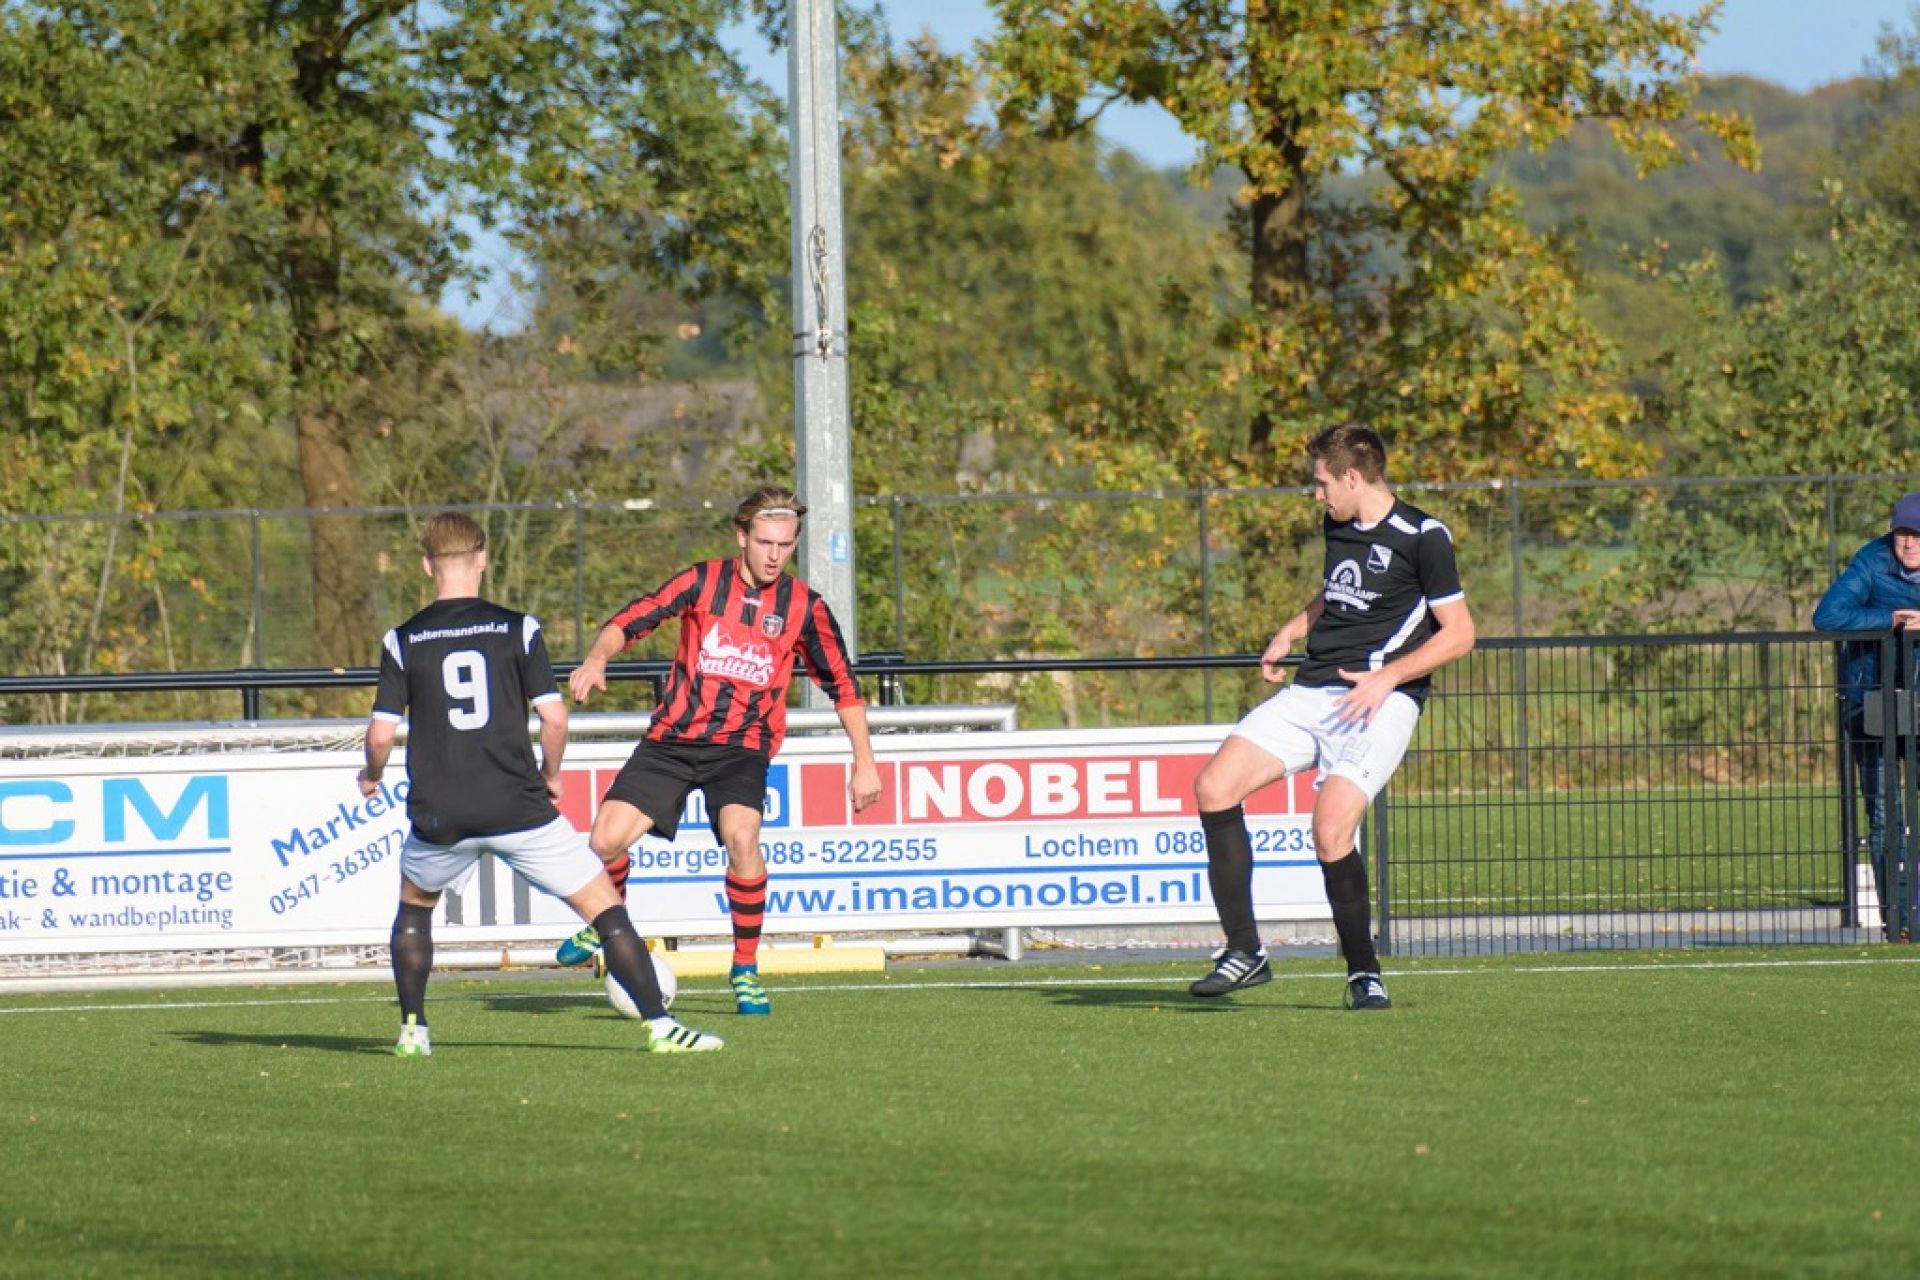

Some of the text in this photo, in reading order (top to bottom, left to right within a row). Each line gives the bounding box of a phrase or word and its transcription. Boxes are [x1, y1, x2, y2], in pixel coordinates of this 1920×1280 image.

[409, 621, 509, 644] holtermanstaal.nl
[442, 649, 491, 732] 9
[908, 759, 1183, 819] NOBEL
[1025, 832, 1138, 858] Lochem
[52, 867, 76, 897] &
[91, 870, 233, 902] montage
[41, 908, 58, 929] &
[69, 903, 233, 932] wandbeplating
